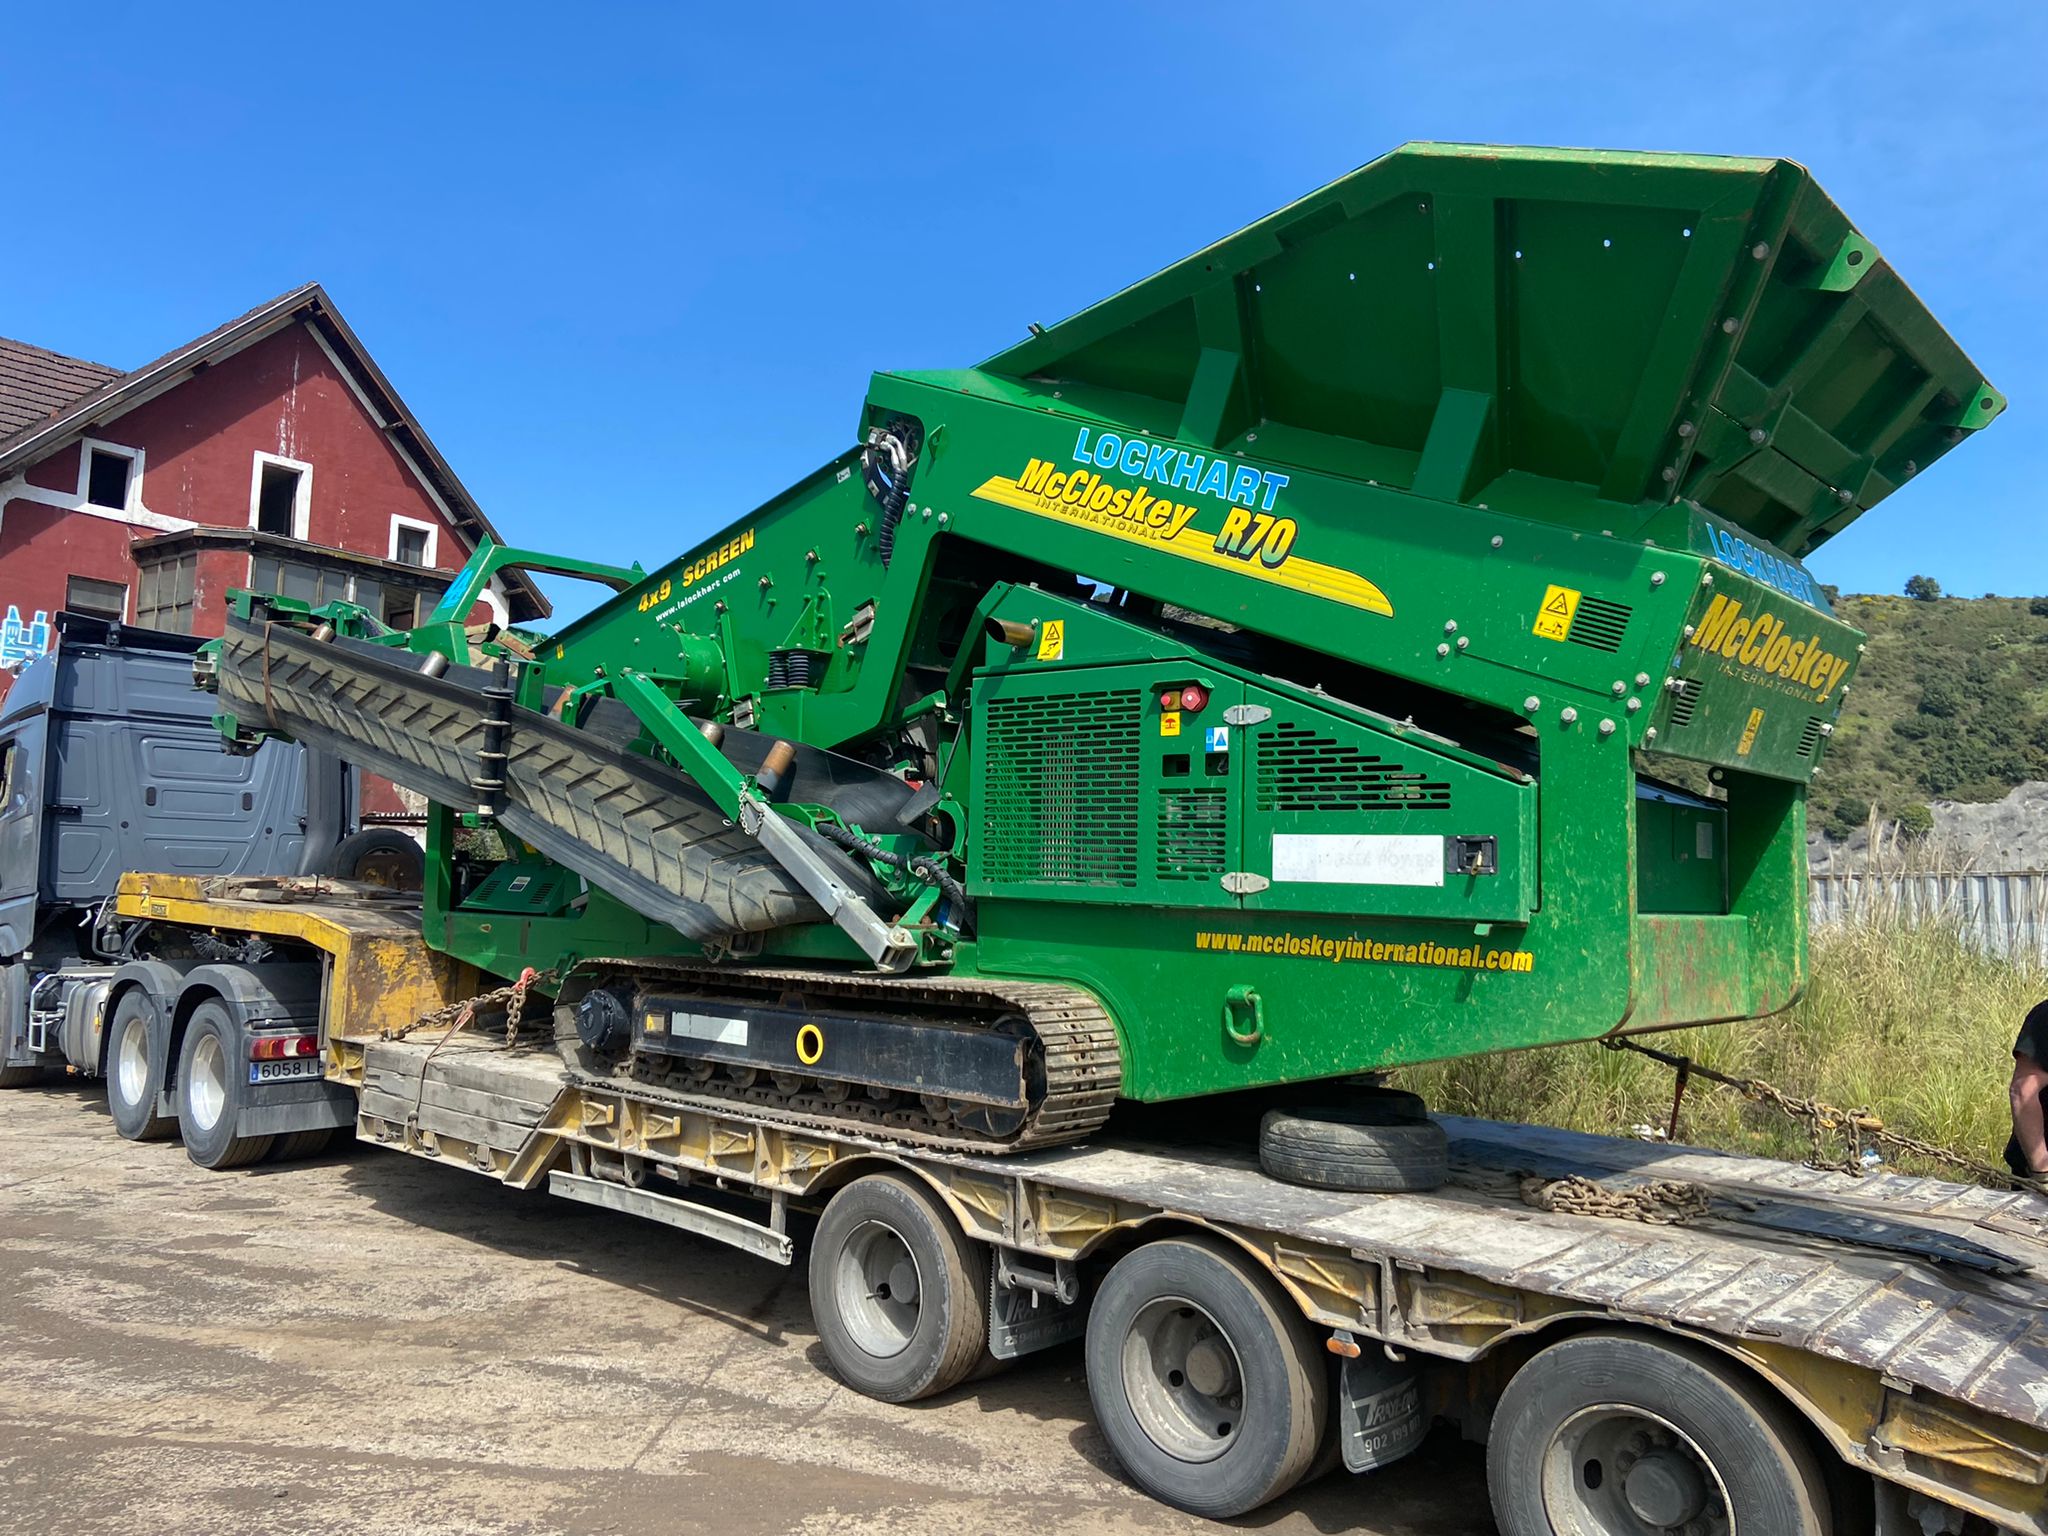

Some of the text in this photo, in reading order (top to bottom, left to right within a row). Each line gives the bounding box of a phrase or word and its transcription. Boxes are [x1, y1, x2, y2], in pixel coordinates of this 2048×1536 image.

[1072, 427, 1290, 512] LOCKHART
[1015, 458, 1298, 569] McCloskey R70
[1035, 496, 1158, 541] INTERNATIONAL
[638, 528, 755, 613] 4x9 SCREEN
[1705, 522, 1816, 607] LOCKHART
[1690, 593, 1850, 704] McCloskey
[1718, 662, 1814, 704] INTERNATIONAL
[1195, 930, 1534, 972] www.mccloskeyinternational.com
[262, 1062, 301, 1078] 6058
[1364, 1433, 1388, 1453] 902
